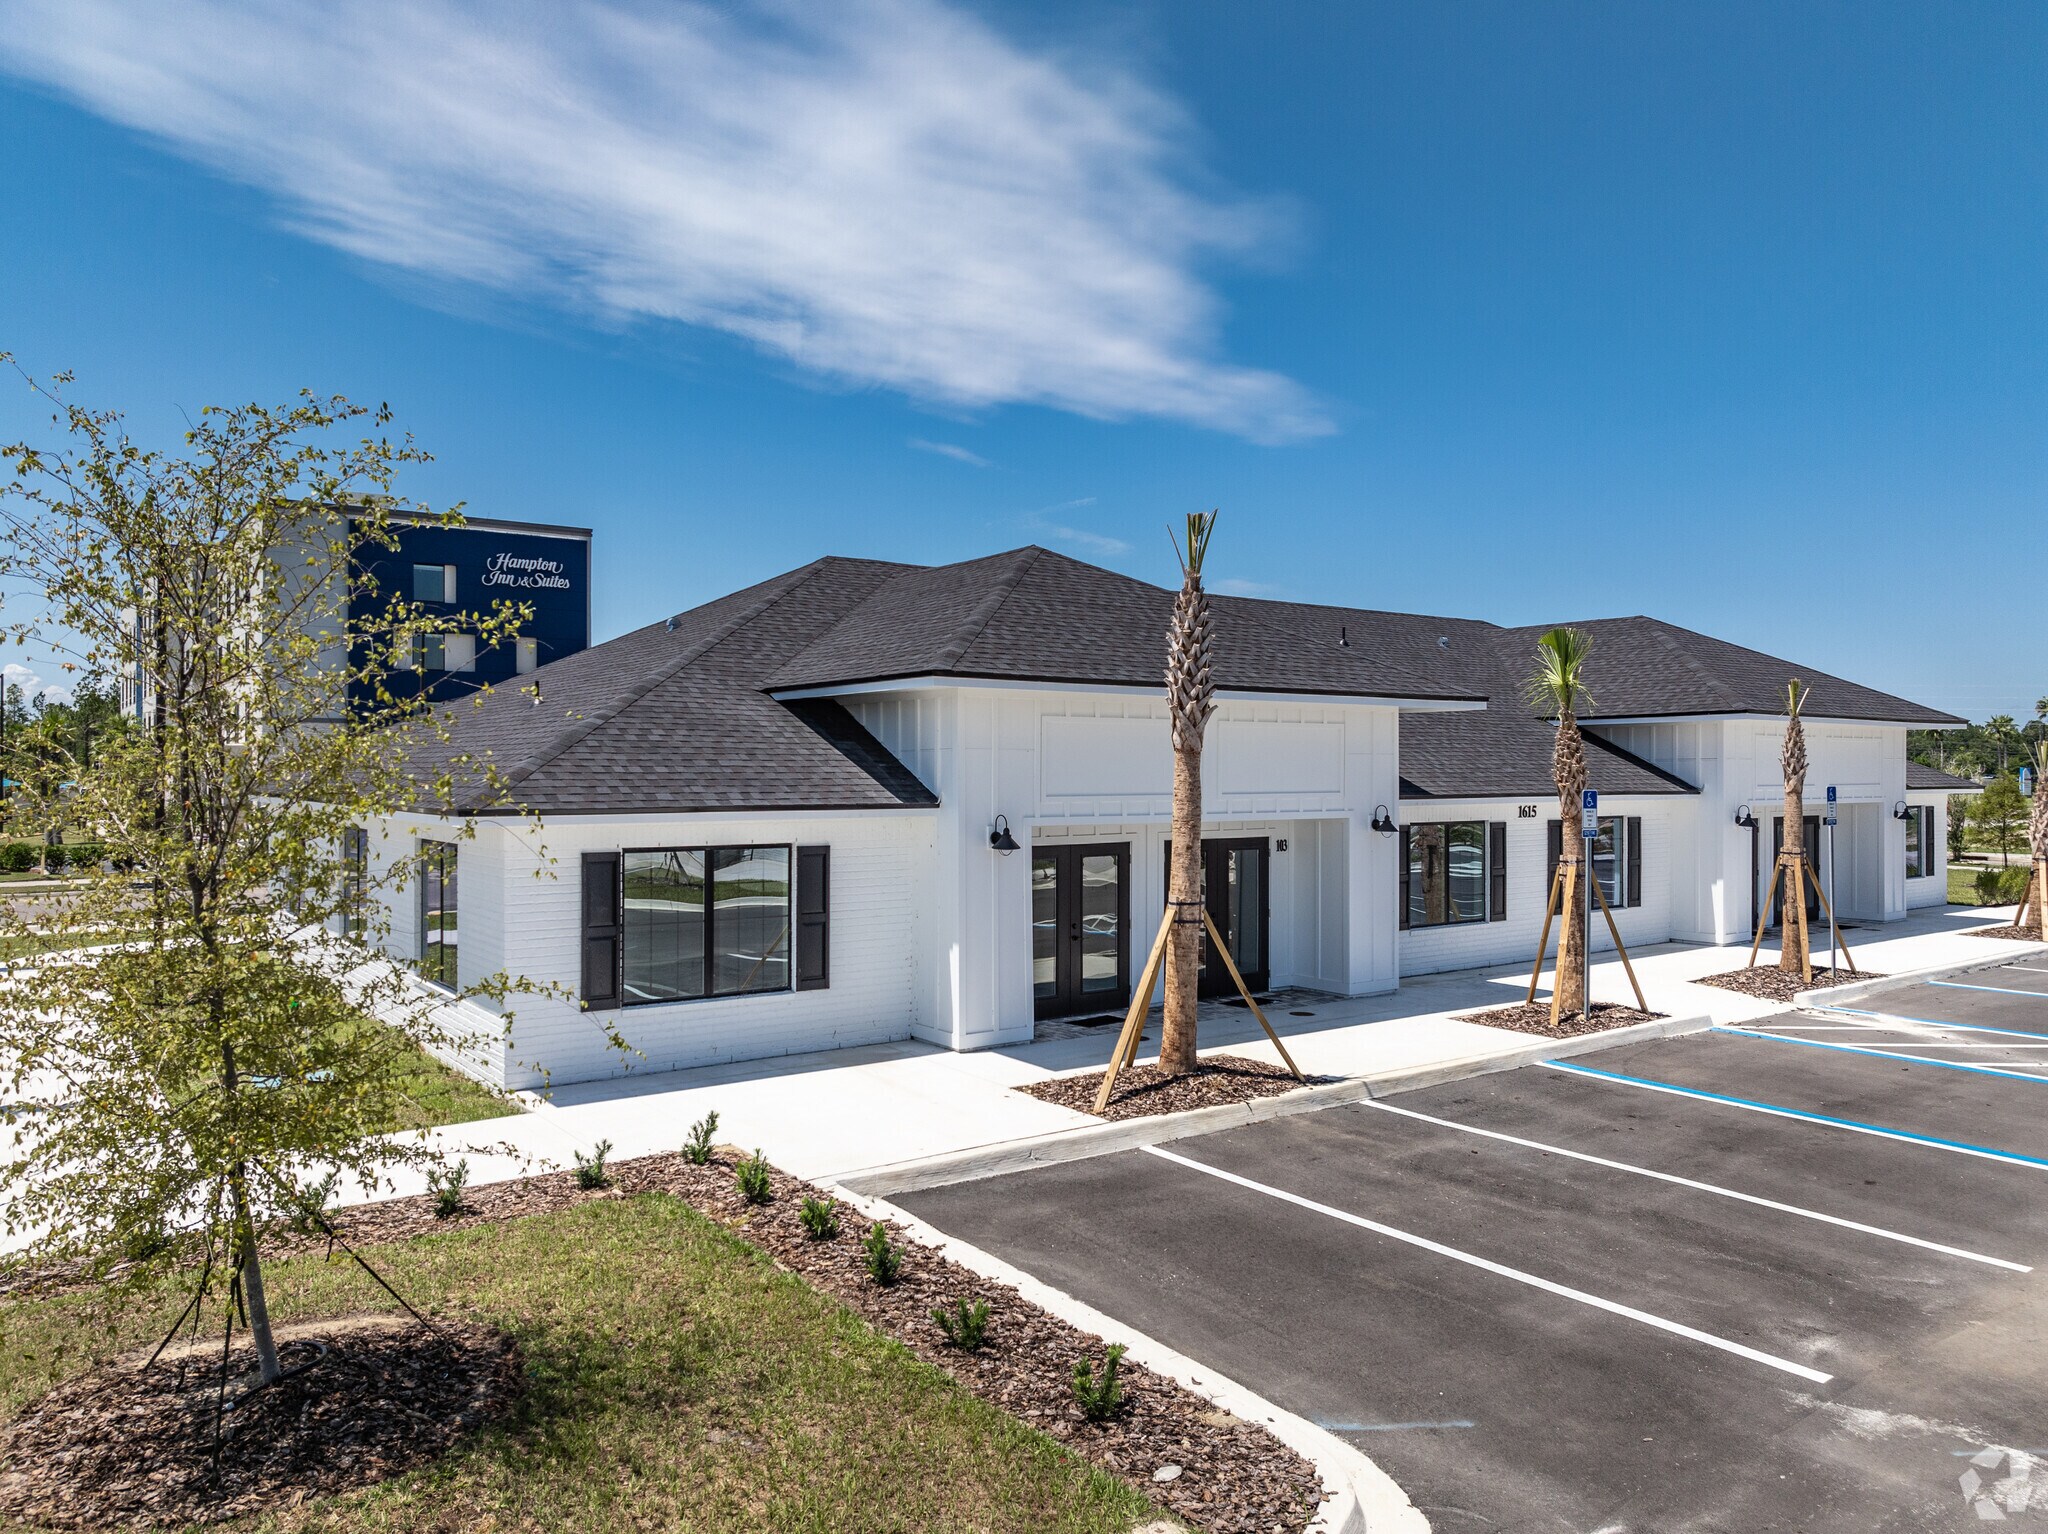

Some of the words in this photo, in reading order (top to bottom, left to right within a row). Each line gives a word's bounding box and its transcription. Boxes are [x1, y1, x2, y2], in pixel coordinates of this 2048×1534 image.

[487, 553, 563, 573] Hampton
[481, 571, 521, 587] Inn
[520, 576, 531, 588] &
[529, 573, 570, 589] Suites
[1518, 805, 1537, 818] 1615
[1276, 839, 1288, 852] 103
